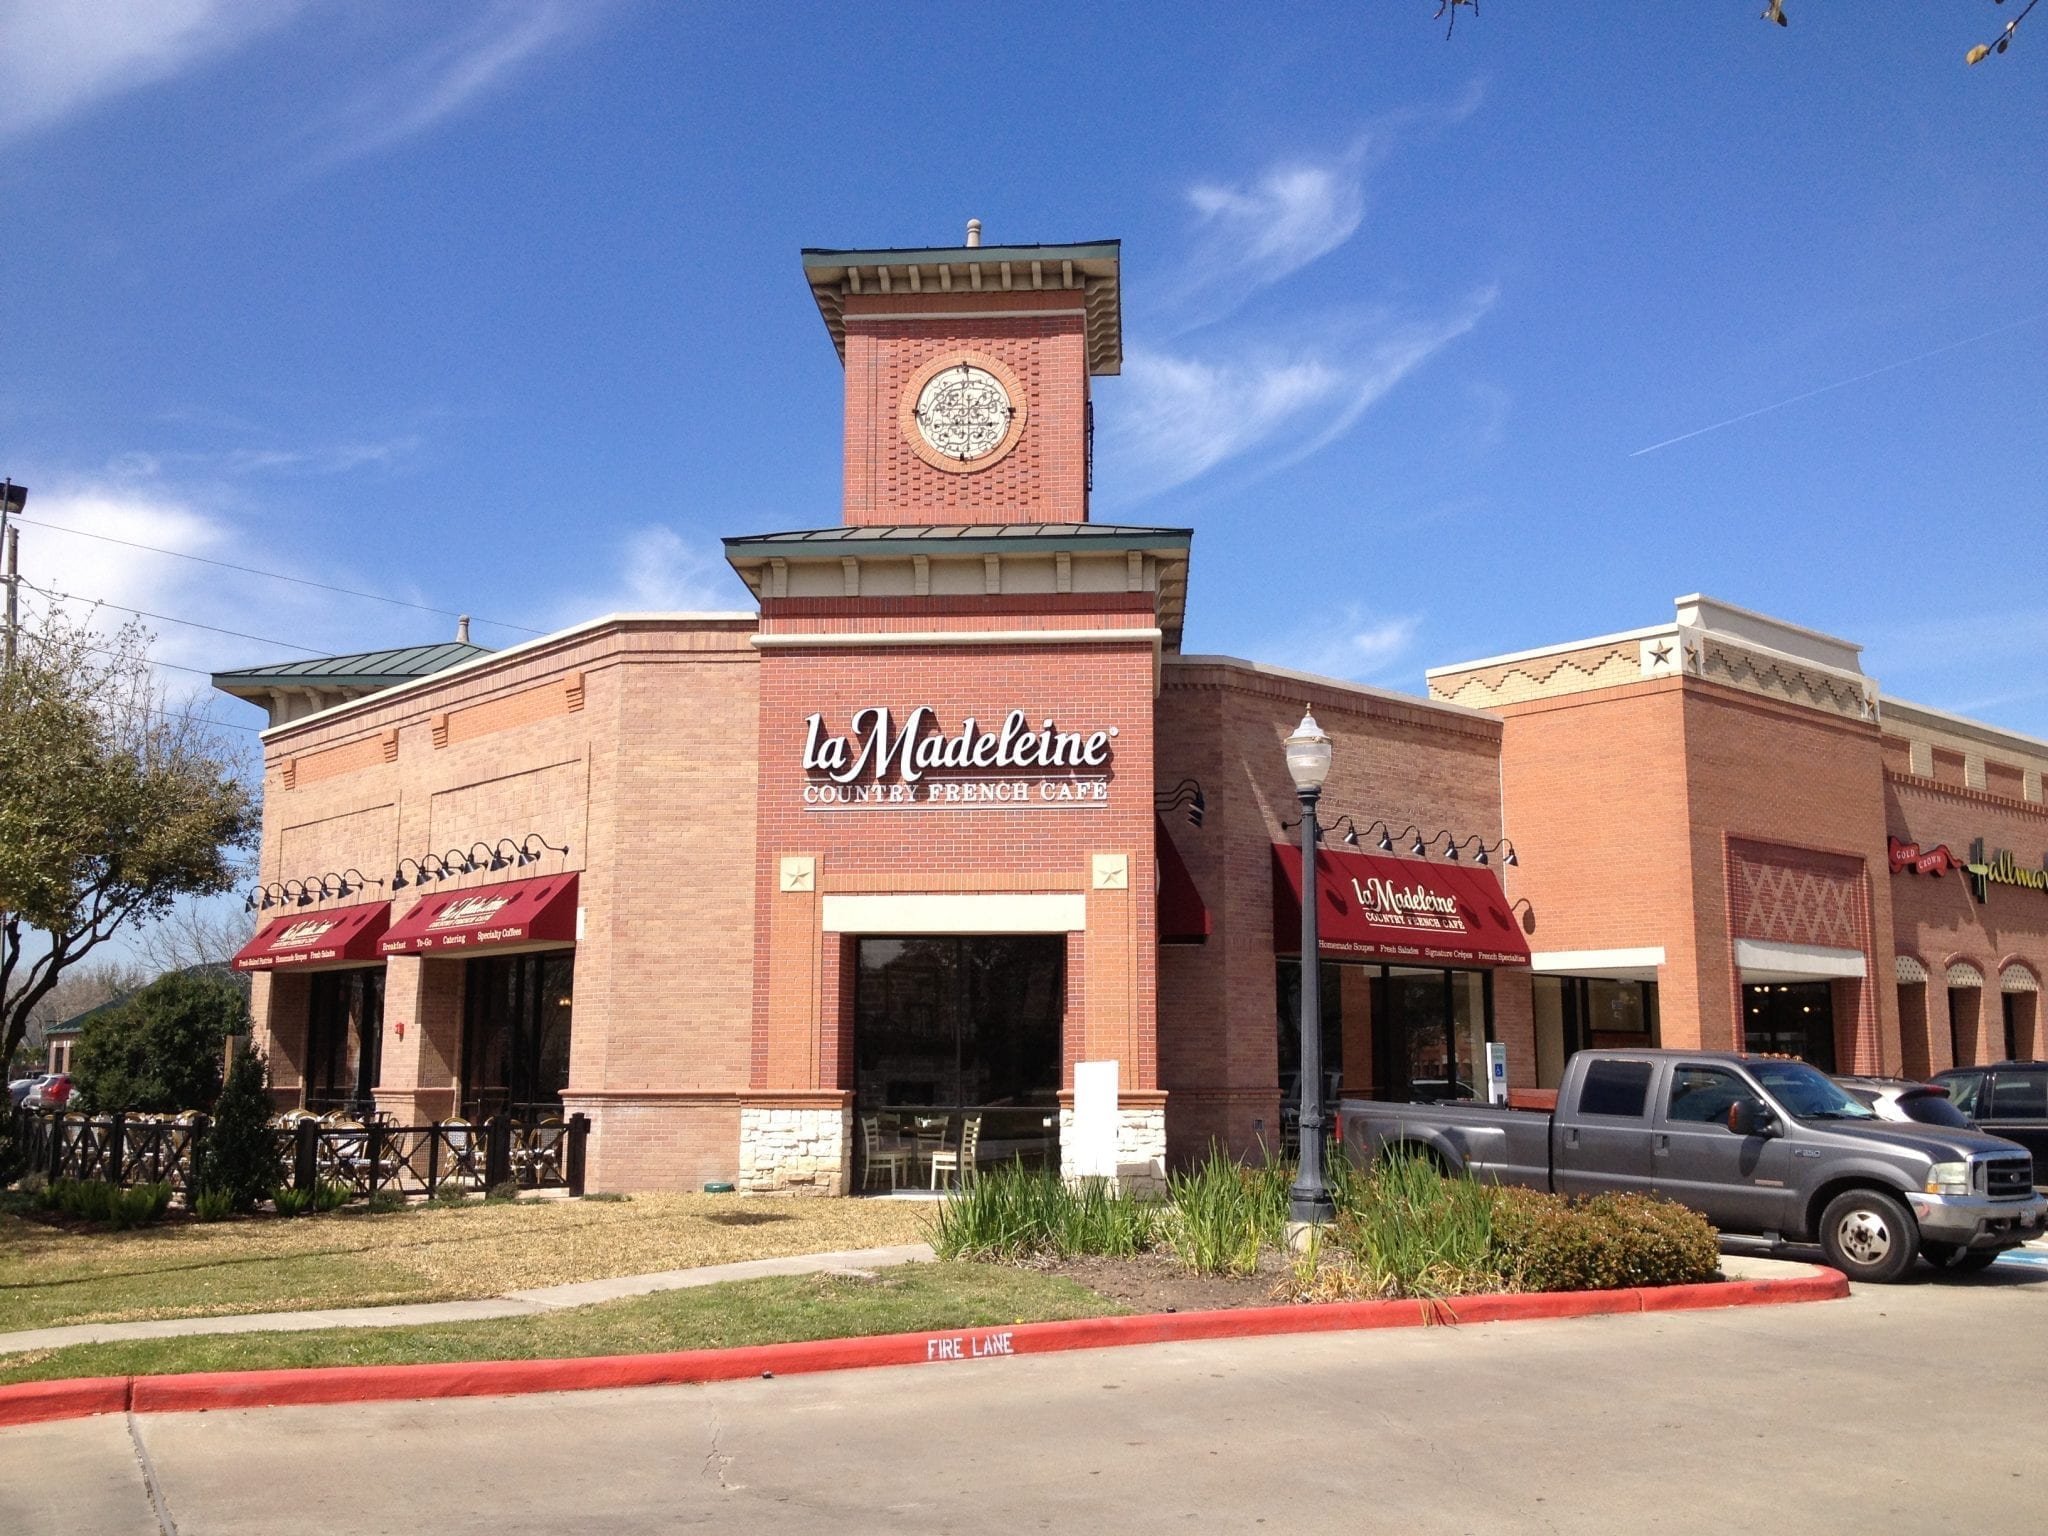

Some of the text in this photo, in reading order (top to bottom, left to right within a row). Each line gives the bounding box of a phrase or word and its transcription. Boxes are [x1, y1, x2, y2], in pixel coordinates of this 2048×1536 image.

[802, 706, 1107, 783] la Madeleine
[803, 778, 1108, 804] COUNTRY FRENCH CAFÉ
[1896, 849, 1915, 860] GOLD
[1918, 855, 1942, 869] CROWN
[1352, 878, 1457, 914] la Madeleine
[1366, 912, 1406, 925] COUNTRY
[1407, 916, 1441, 928] FRENCH
[382, 928, 522, 951] Breakfast To-Go Catering Specialty Coffees
[1318, 940, 1353, 951] Homemade
[1380, 945, 1397, 954] Fresh
[1425, 948, 1453, 958] Signature
[927, 1332, 1015, 1360] FIRE LANE
